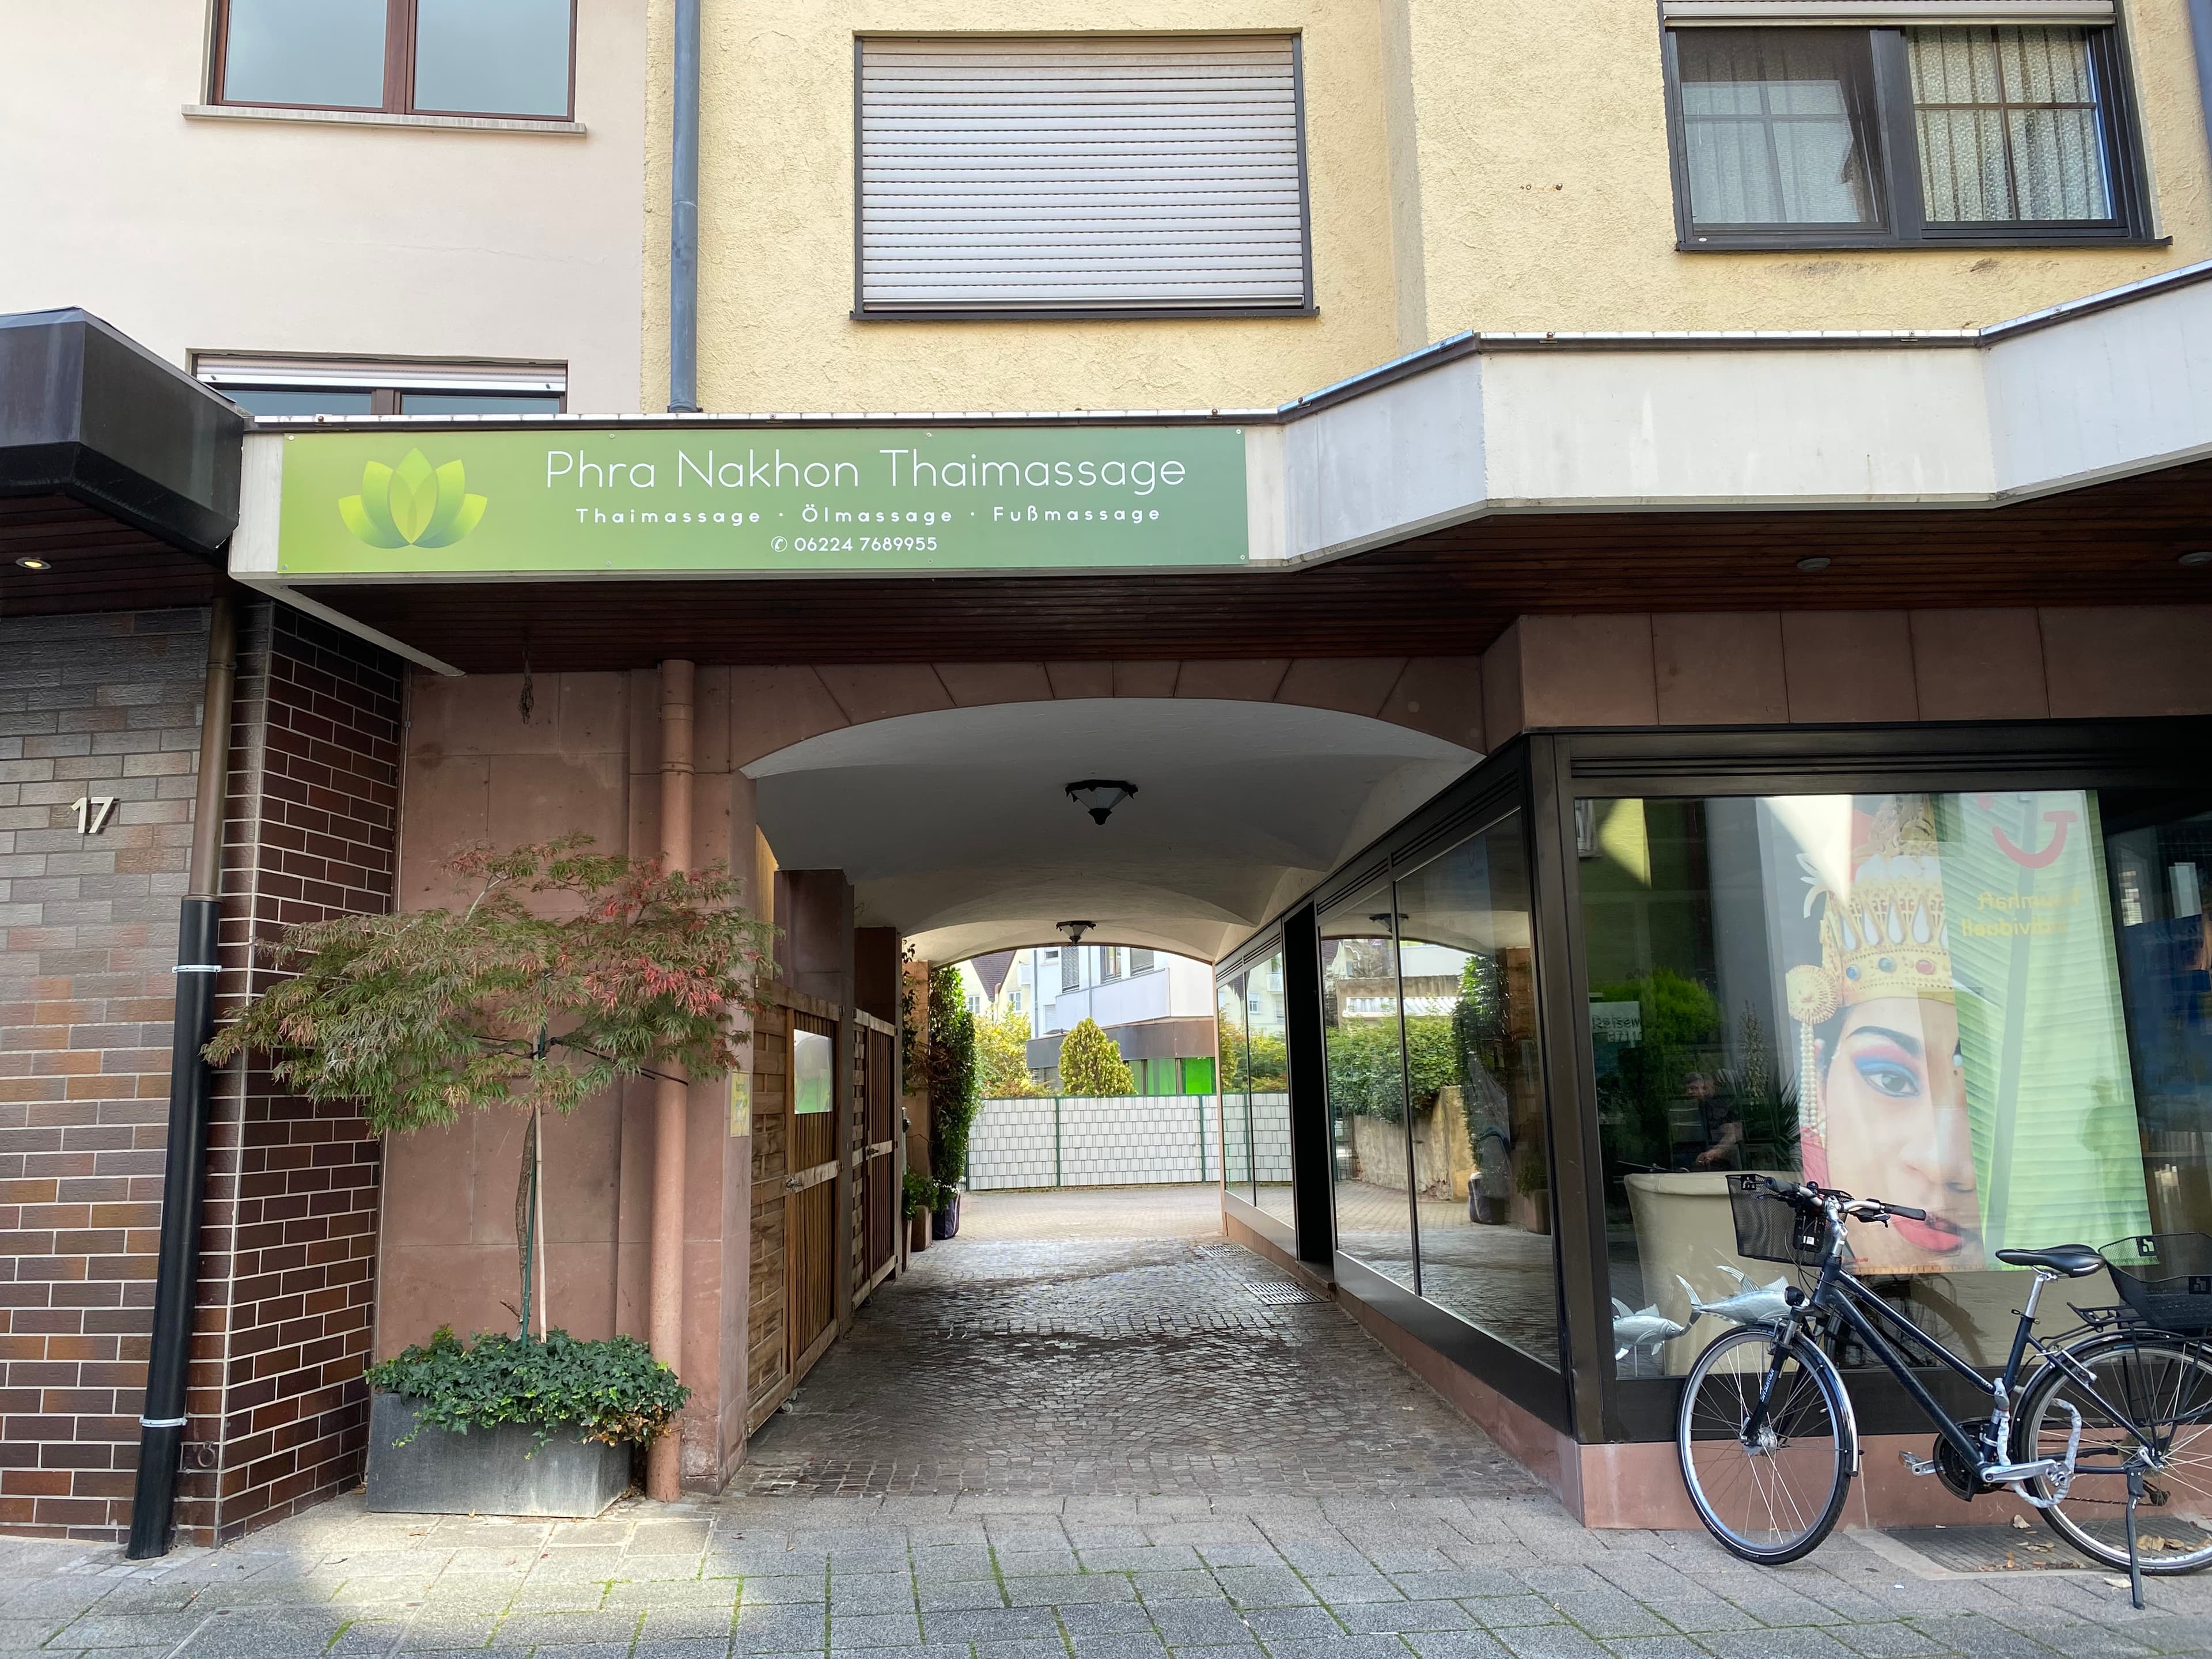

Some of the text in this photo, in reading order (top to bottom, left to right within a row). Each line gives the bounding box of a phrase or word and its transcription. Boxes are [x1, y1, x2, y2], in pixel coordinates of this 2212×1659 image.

[547, 448, 1186, 495] Phra Nakhon Thaimassage
[575, 503, 1160, 527] Thaimassage Ölmassage Fußmassage
[794, 536, 937, 552] 06224 7689955
[71, 796, 115, 834] 17
